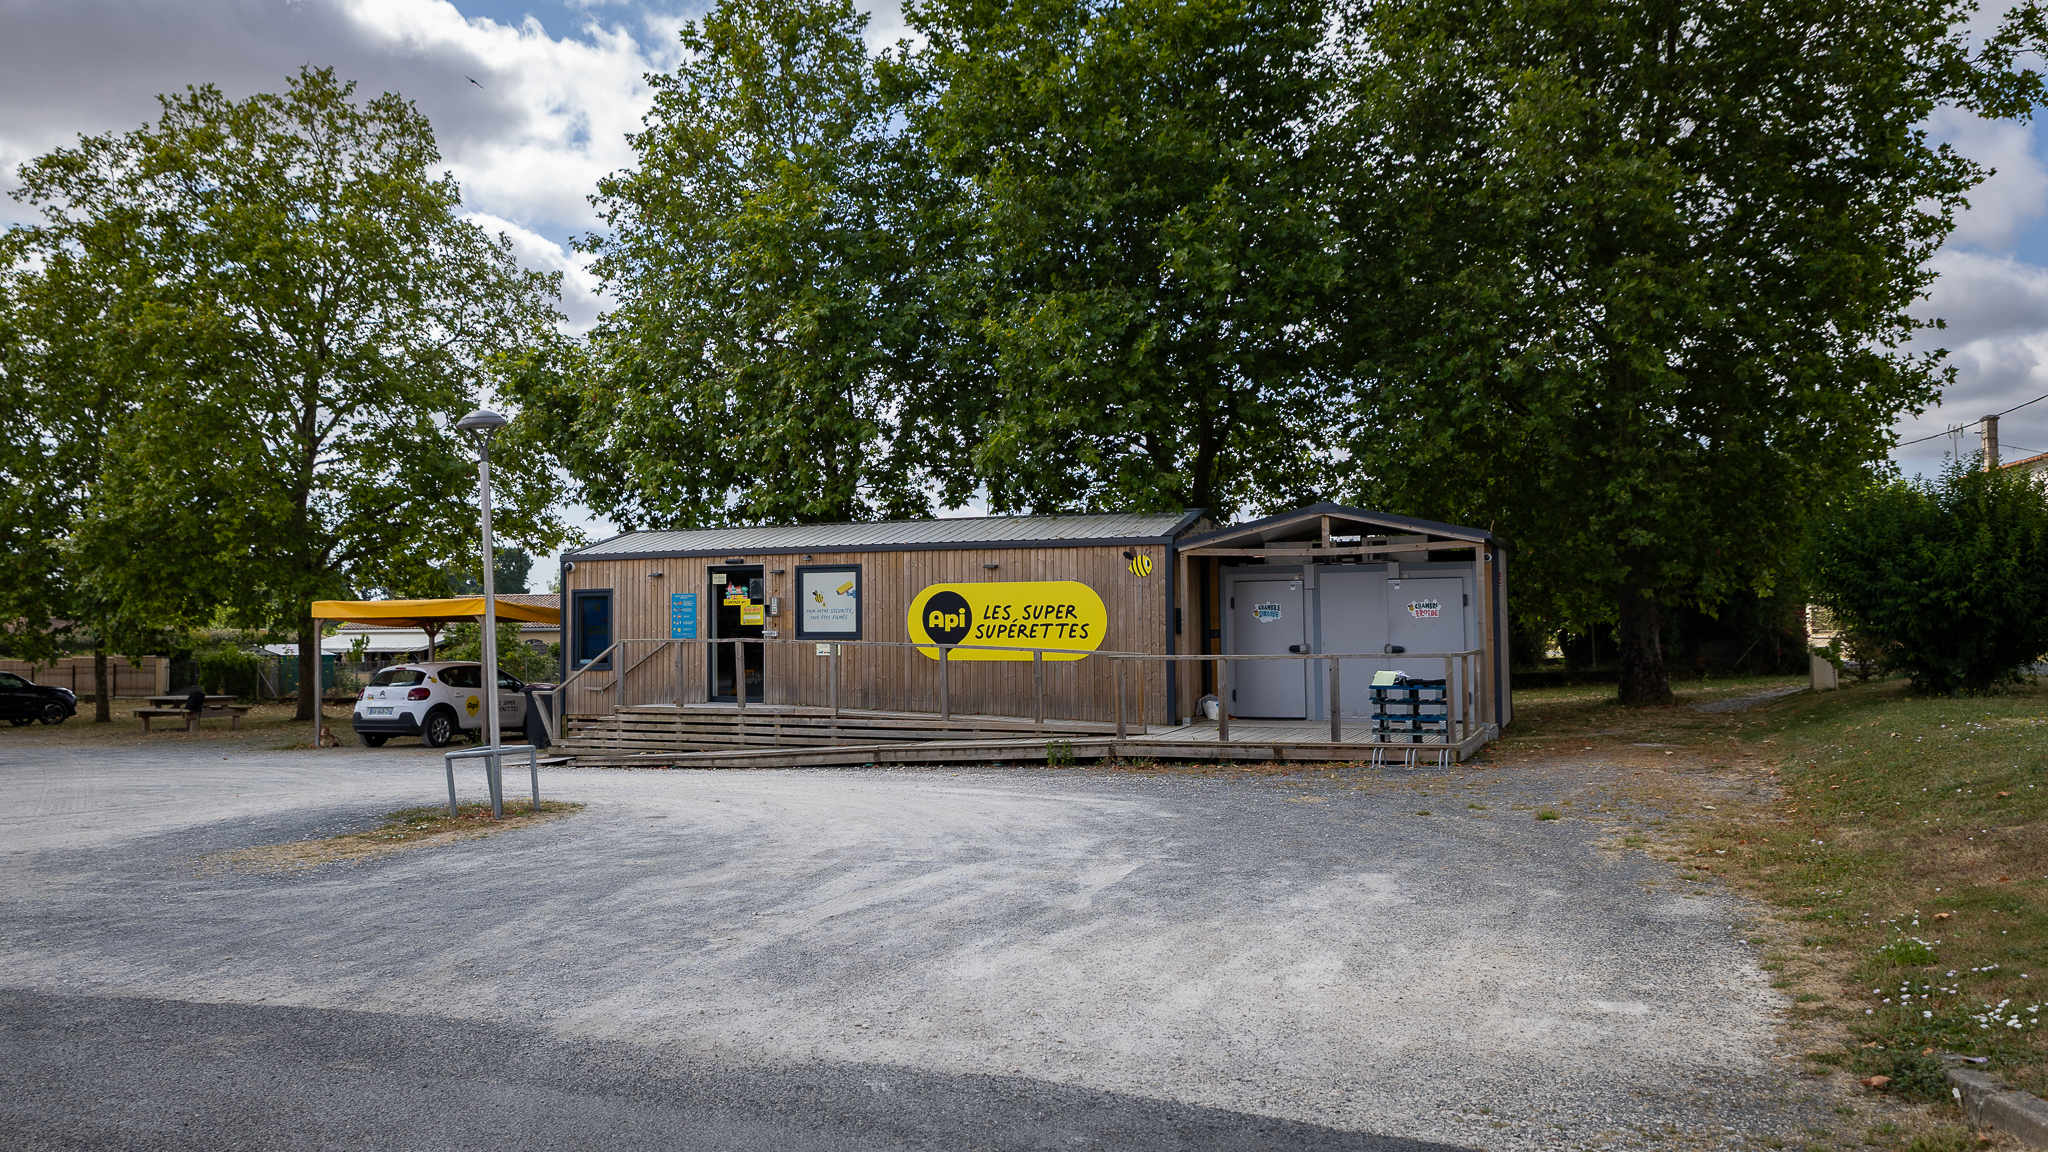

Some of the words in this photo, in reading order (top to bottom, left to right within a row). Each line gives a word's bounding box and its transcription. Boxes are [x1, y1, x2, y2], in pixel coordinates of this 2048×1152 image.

[928, 607, 966, 632] Api
[983, 604, 1012, 621] LES
[1022, 604, 1078, 620] SUPER
[1415, 609, 1439, 617] FROIDE
[975, 618, 1090, 639] SUPÉRETTES
[467, 701, 479, 710] Api
